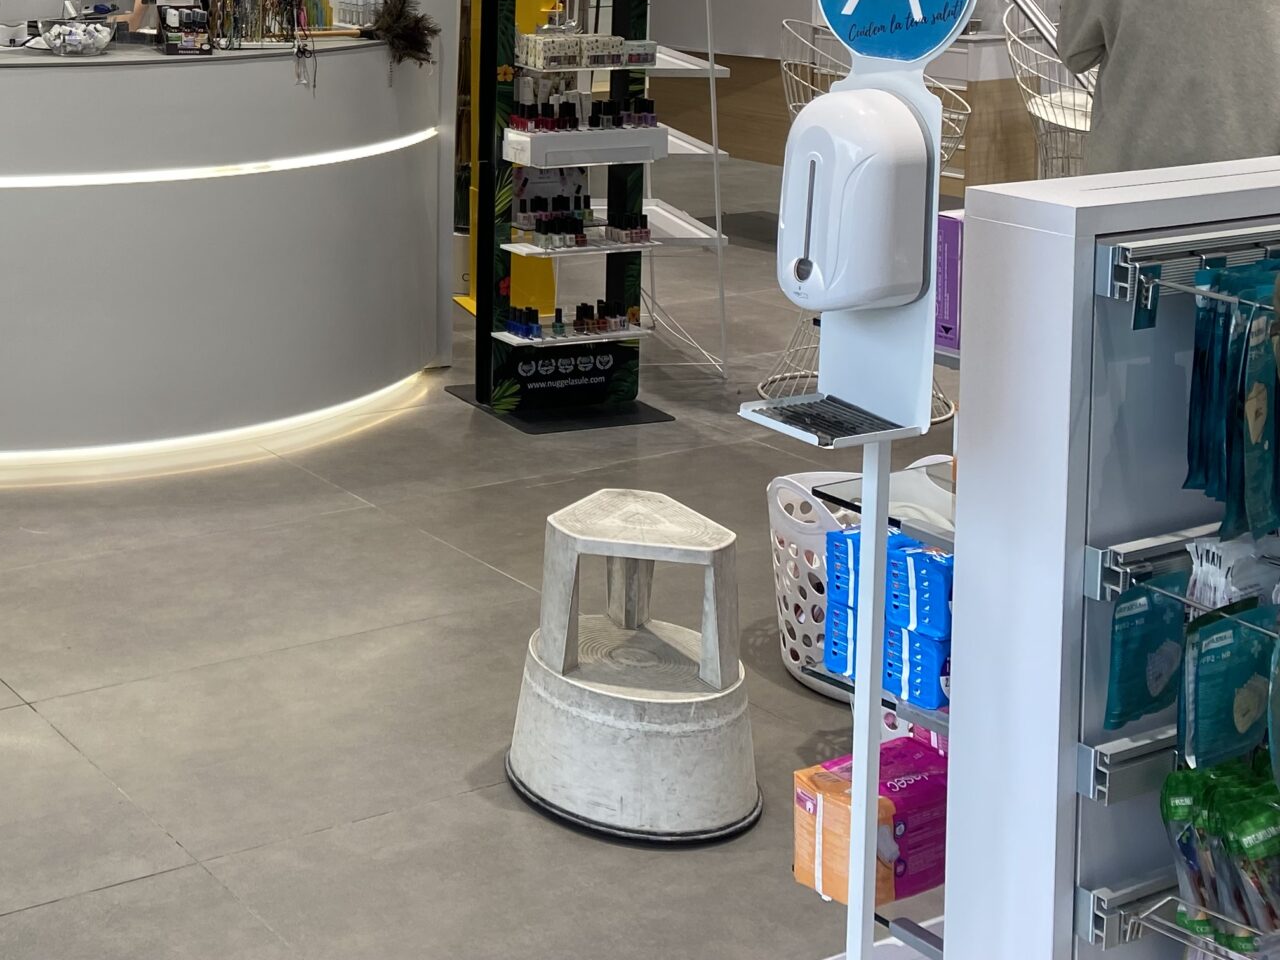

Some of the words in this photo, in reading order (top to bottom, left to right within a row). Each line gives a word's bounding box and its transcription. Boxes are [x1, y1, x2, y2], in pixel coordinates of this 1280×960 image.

[848, 23, 887, 42] Cuidem
[890, 14, 903, 34] la
[527, 375, 606, 390] www.nuggelasule.com
